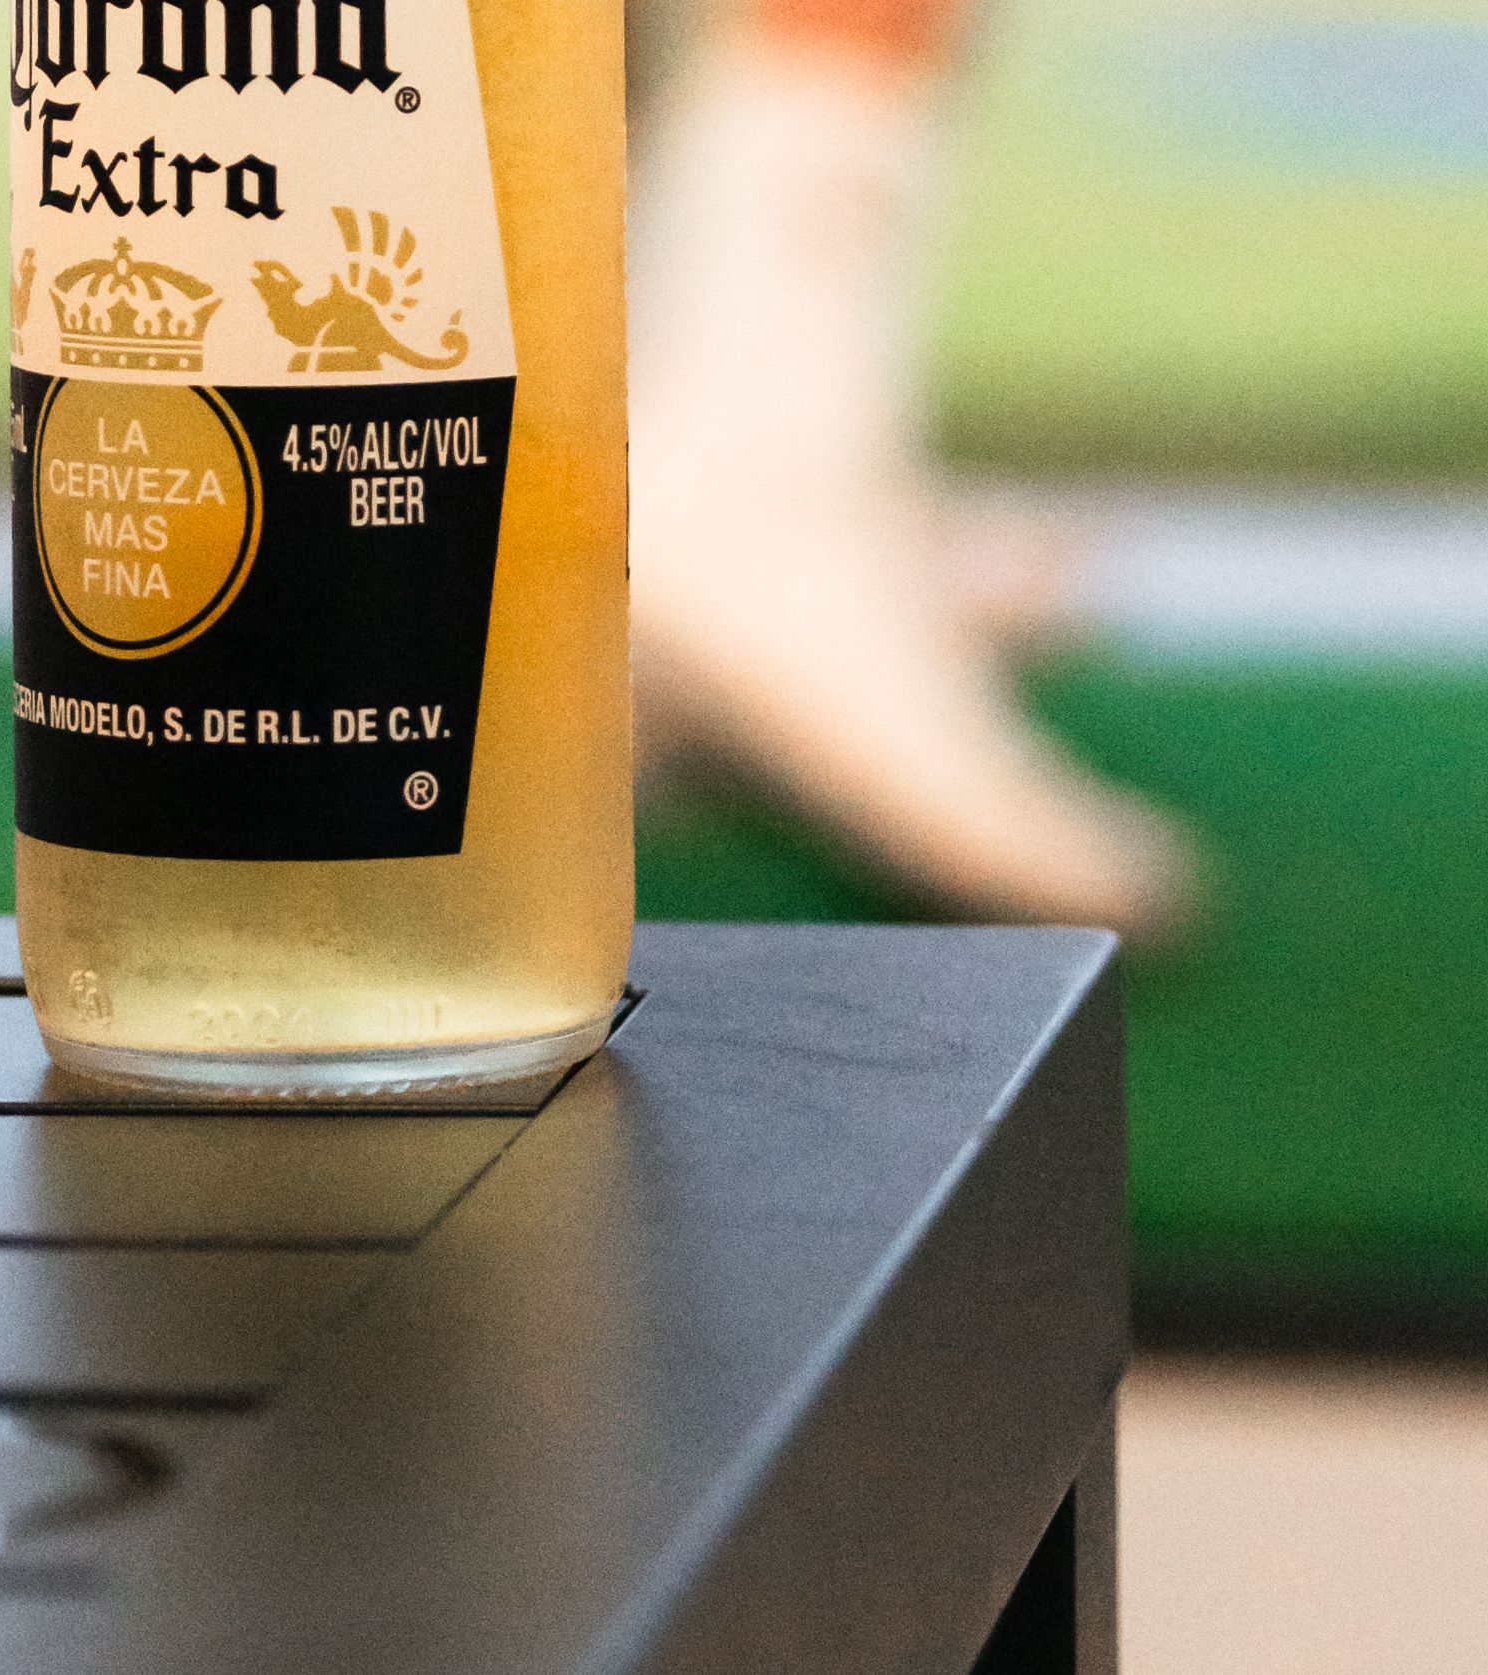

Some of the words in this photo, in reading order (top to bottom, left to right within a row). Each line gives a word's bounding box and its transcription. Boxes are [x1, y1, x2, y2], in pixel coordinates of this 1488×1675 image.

[38, 98, 287, 220] Extra
[97, 417, 149, 455] LA
[48, 459, 227, 507] CERVEZA
[349, 476, 426, 527] BEER
[84, 509, 169, 552] MAS
[81, 557, 171, 600] FINA
[50, 694, 155, 747] MODELO,
[163, 706, 193, 743] S.
[203, 708, 247, 745] DE
[257, 709, 321, 745] R.L.
[332, 707, 379, 745] DE
[388, 704, 452, 744] C.V.
